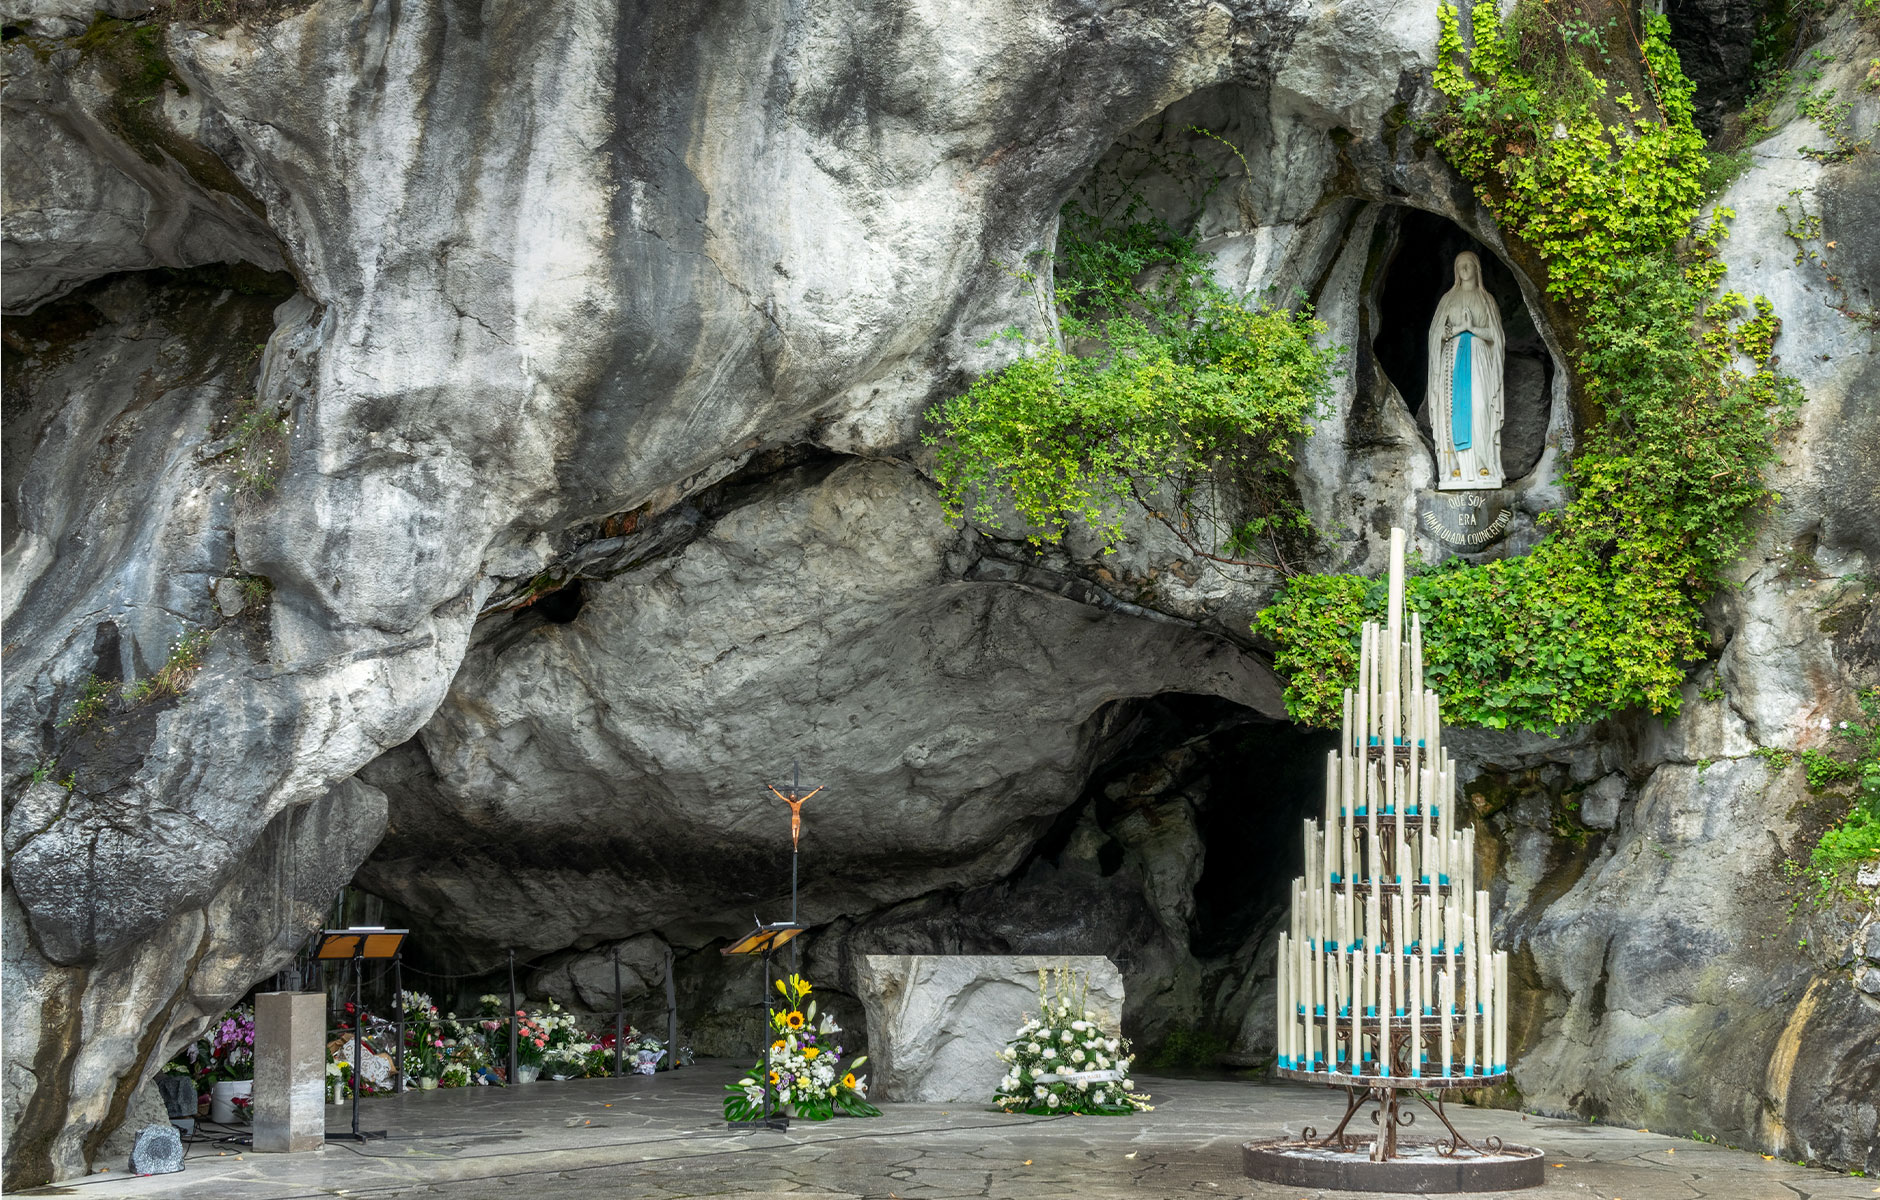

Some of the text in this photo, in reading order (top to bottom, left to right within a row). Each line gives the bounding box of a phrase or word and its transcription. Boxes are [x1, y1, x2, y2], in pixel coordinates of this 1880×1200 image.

[1448, 495, 1486, 509] QUE SOY
[1458, 513, 1477, 526] ERA
[1423, 509, 1512, 545] IMMACULADA COUNCEPCIOU
